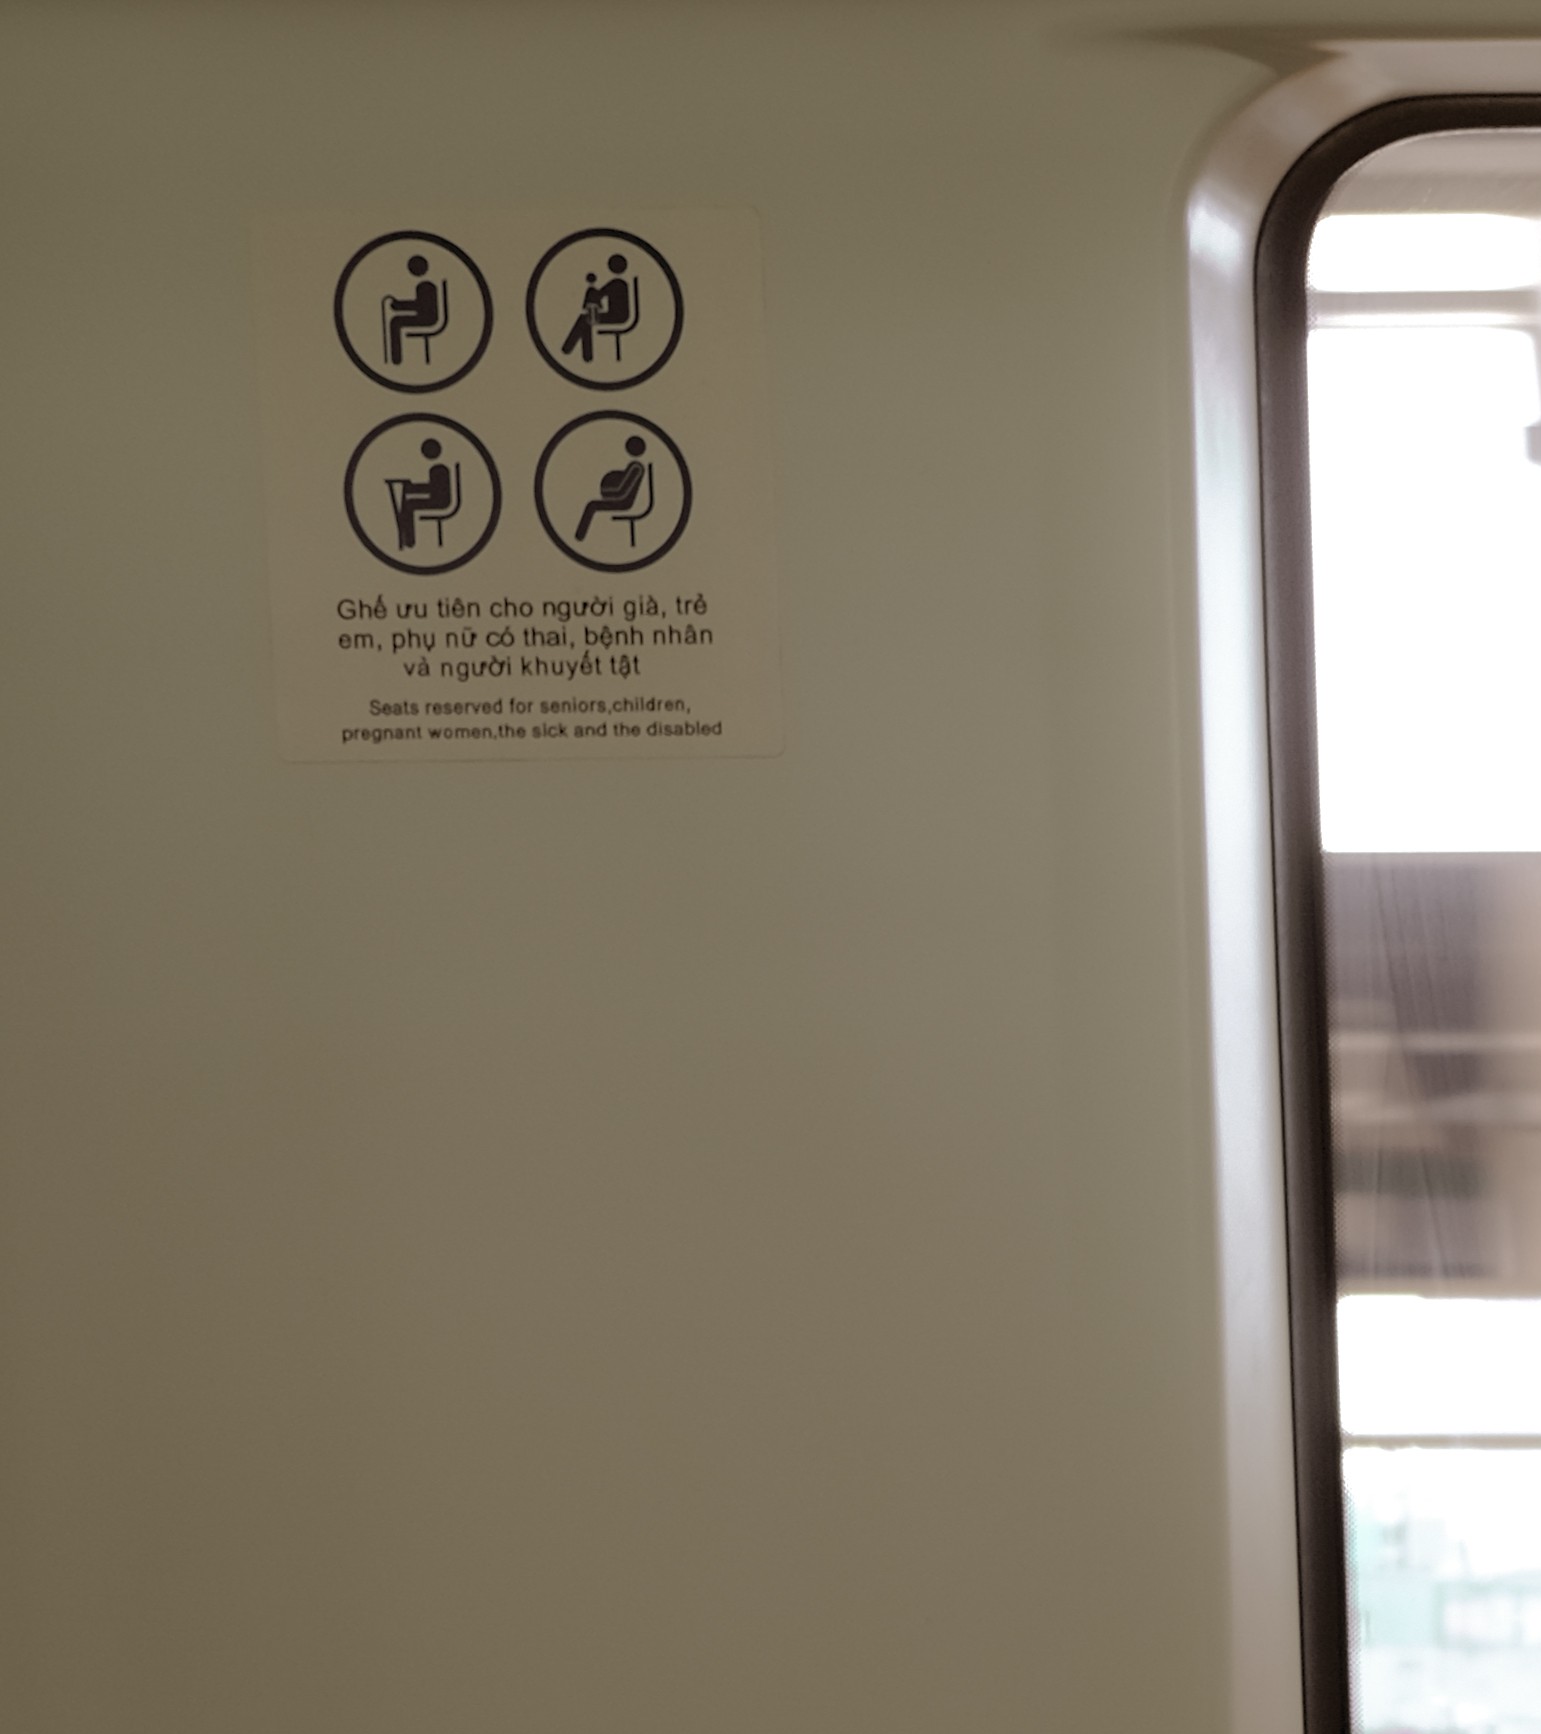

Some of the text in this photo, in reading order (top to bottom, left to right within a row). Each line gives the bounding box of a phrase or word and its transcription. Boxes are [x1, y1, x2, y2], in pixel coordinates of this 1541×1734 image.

[337, 593, 708, 622] Ghế ưu tiên cho người già, trẻ
[339, 625, 712, 654] em, phụ nữ có thai, bệnh nhân
[403, 650, 640, 682] và người khuyết tật
[370, 697, 691, 716] Seats reserved for seniors,children,
[342, 725, 421, 743] pregnant
[532, 723, 568, 738] sick
[574, 722, 607, 738] and
[613, 722, 639, 738] the
[647, 721, 722, 737] disabled
